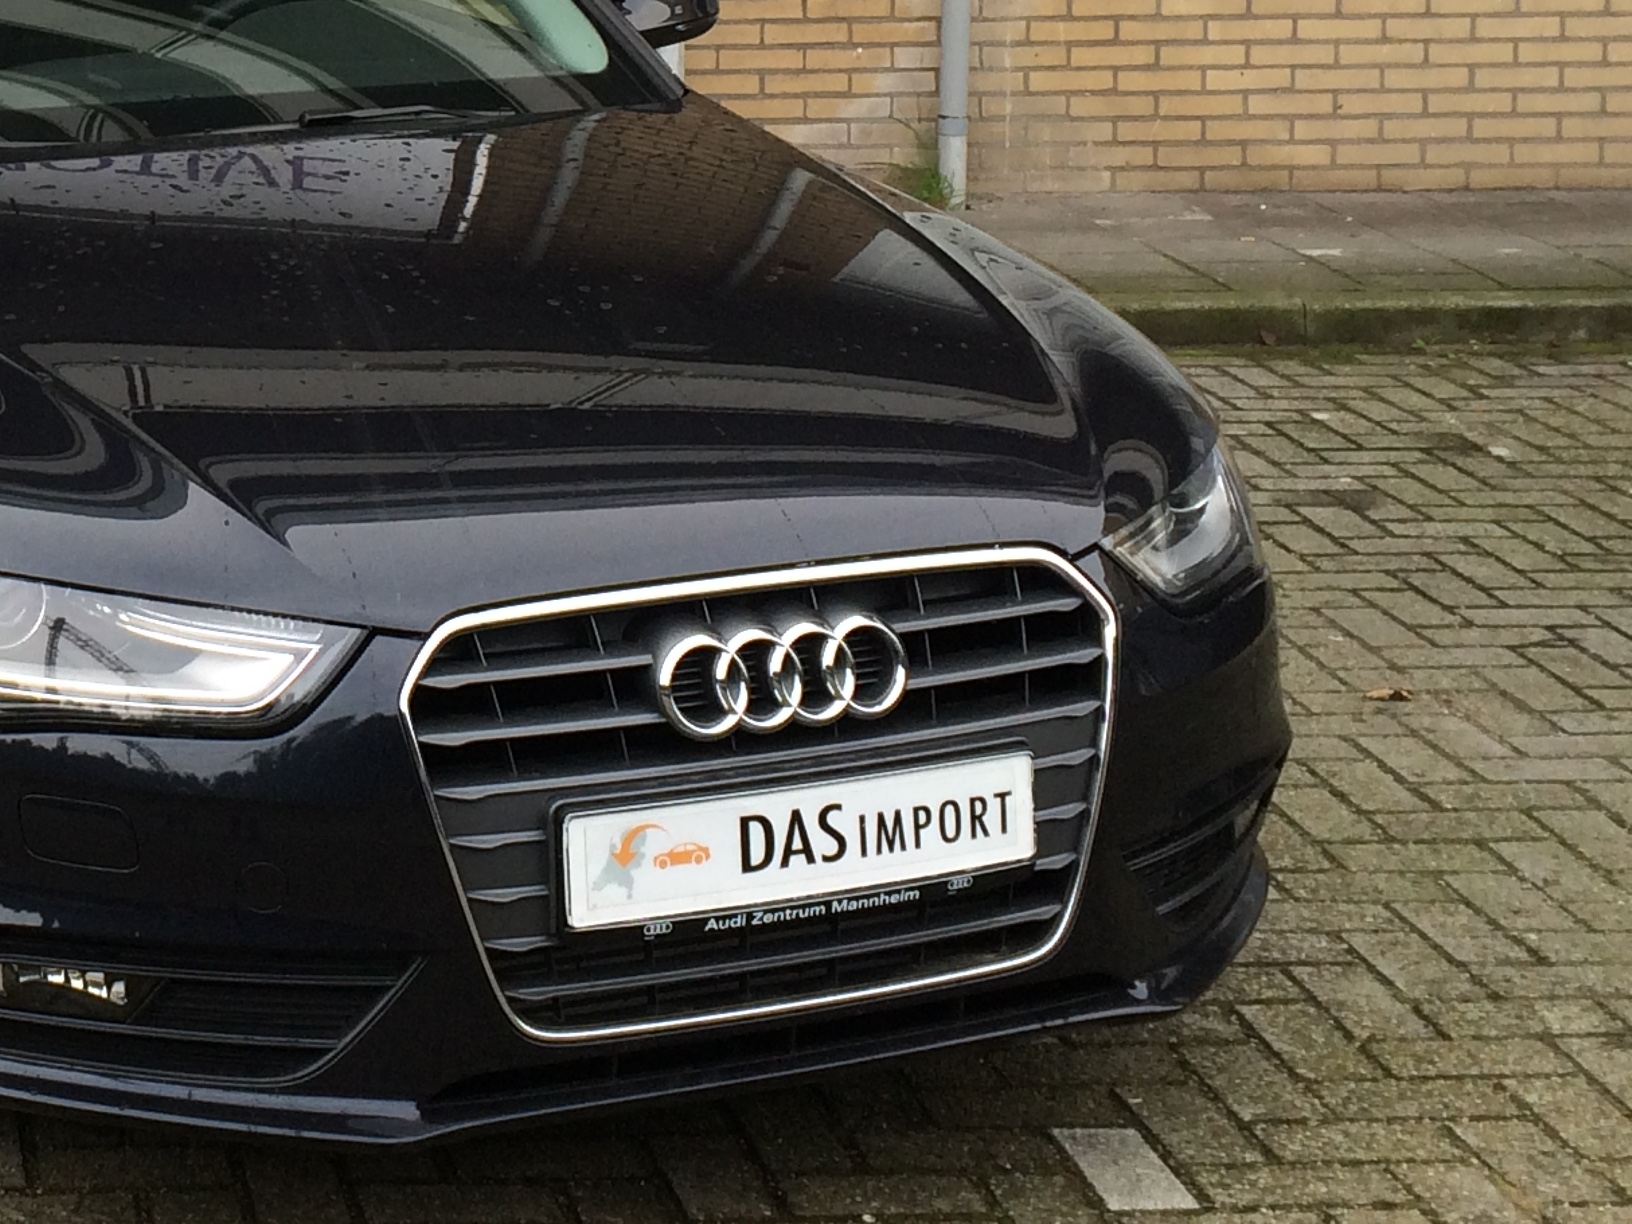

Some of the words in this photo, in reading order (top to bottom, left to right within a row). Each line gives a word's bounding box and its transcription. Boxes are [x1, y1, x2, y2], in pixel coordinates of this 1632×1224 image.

[703, 912, 747, 932] Audi
[750, 903, 826, 926] Zentrum
[831, 888, 921, 914] Mannheim
